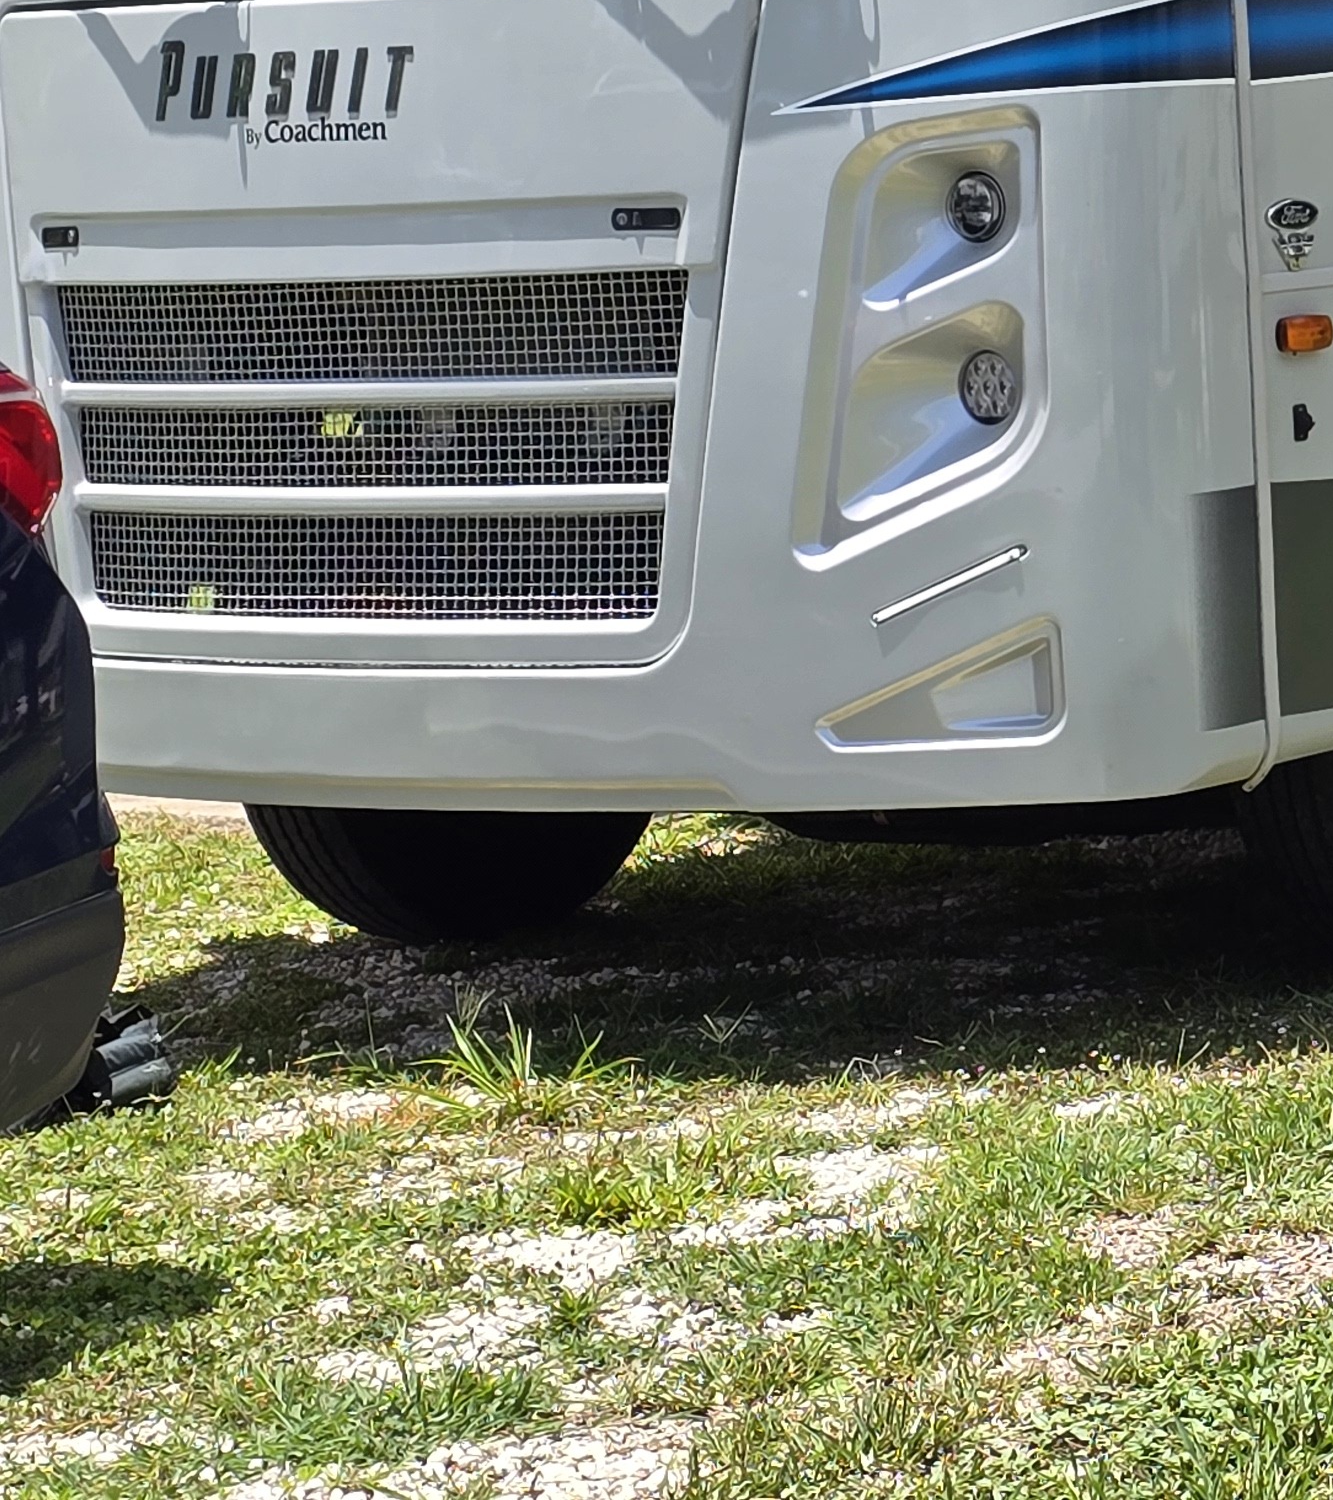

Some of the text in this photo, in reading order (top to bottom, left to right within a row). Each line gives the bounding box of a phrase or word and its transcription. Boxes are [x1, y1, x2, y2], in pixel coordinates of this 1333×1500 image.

[156, 40, 414, 122] PURSUIT
[245, 117, 387, 149] By Coachmen
